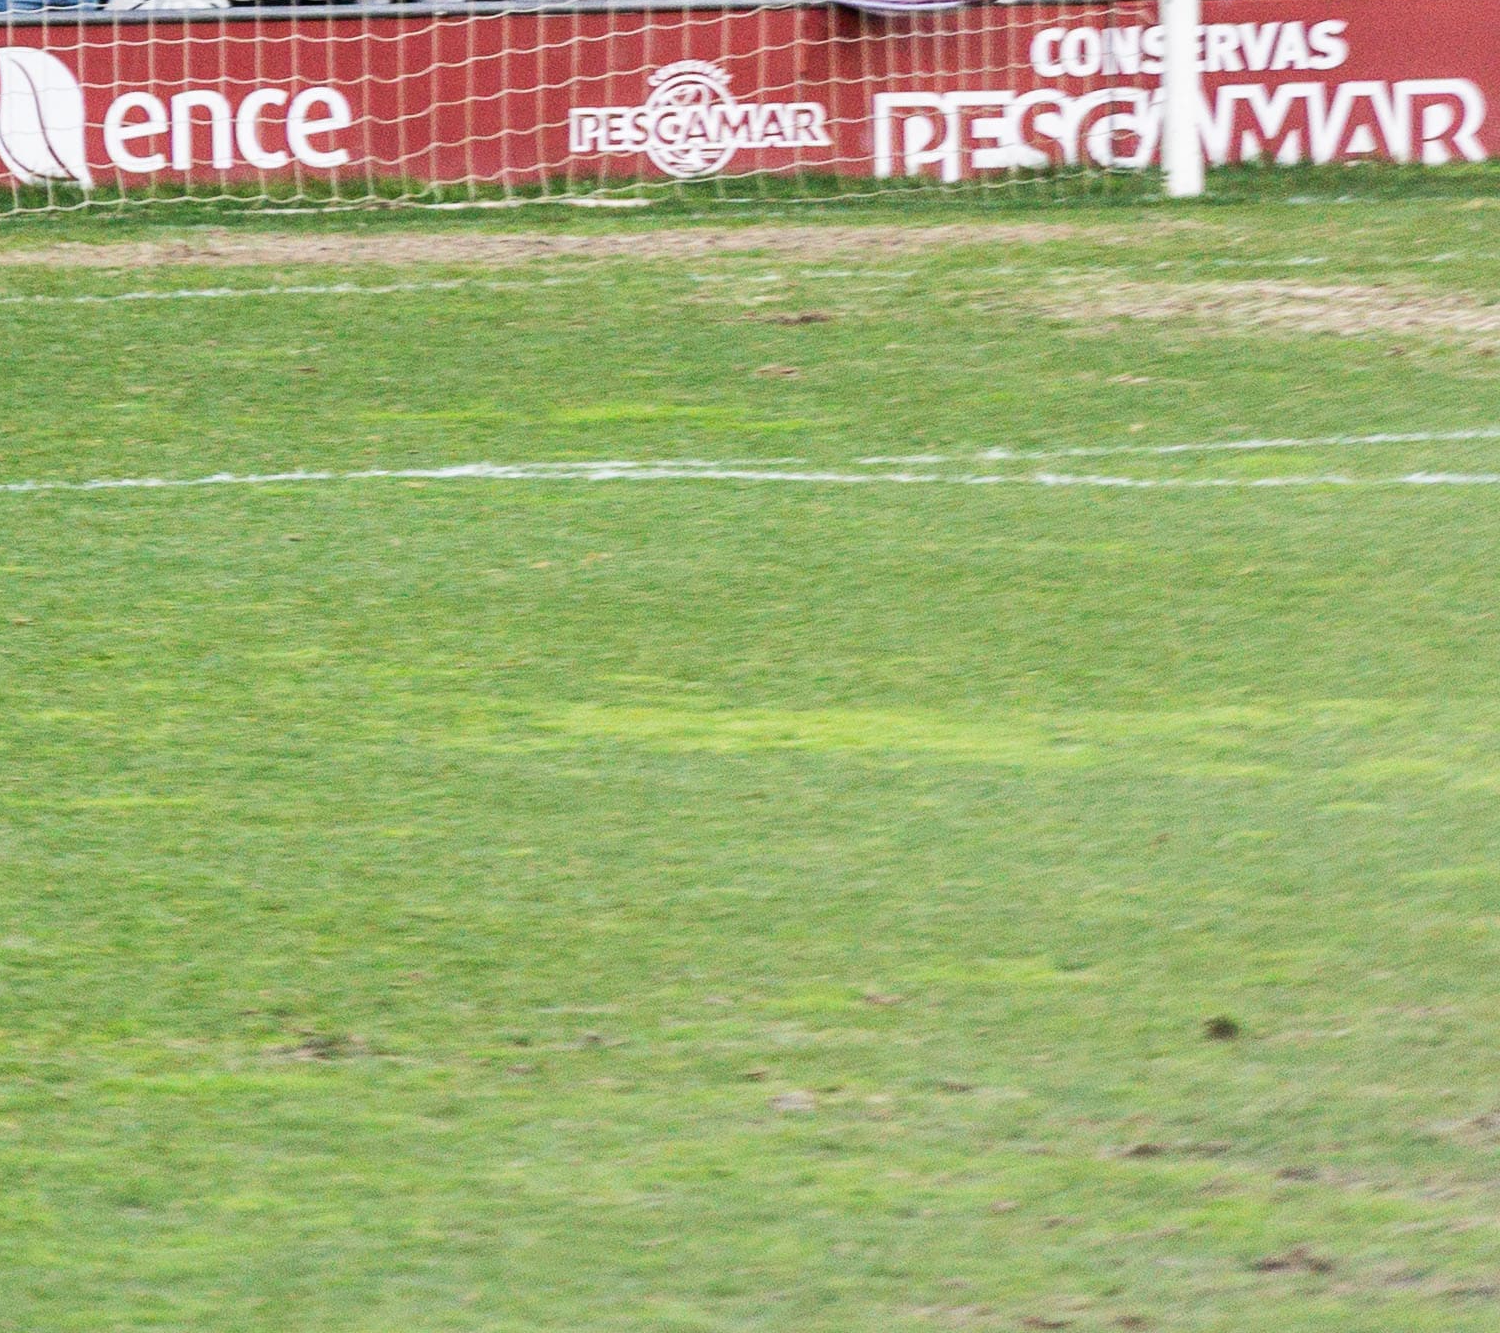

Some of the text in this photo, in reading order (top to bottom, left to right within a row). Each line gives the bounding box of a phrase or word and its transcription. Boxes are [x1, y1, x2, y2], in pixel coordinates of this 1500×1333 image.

[1030, 19, 1349, 78] CONSRVAS
[103, 85, 353, 173] ence
[568, 102, 831, 153] PESCAMAR
